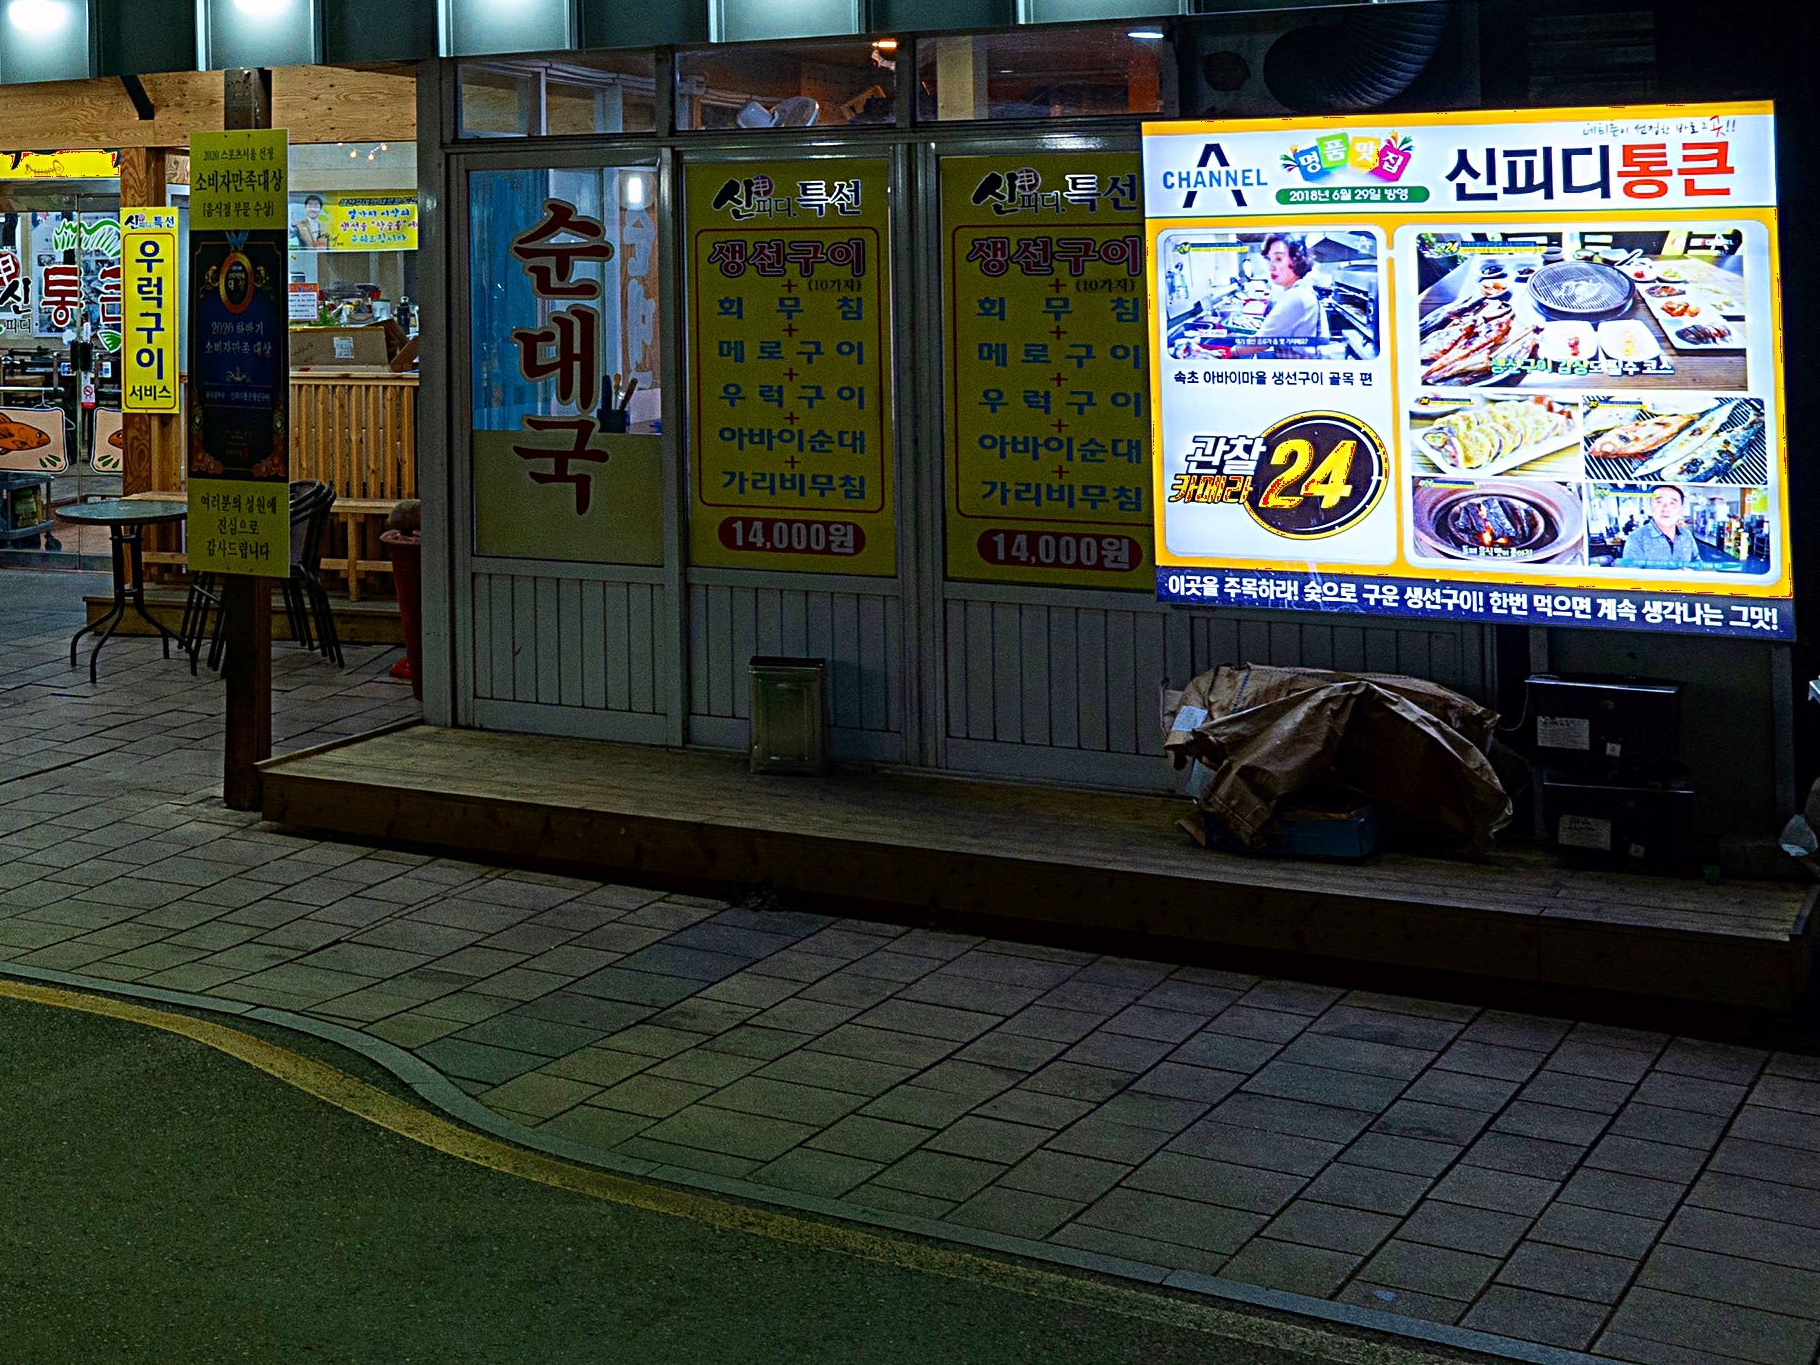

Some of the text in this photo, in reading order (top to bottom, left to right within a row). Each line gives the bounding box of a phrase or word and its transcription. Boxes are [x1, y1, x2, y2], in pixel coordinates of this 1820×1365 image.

[195, 168, 283, 193] 소비자만족대상
[1063, 172, 1138, 213] 특선
[1163, 169, 1268, 189] CHANNEL
[797, 179, 862, 216] 특선
[1289, 188, 1408, 202] 2018년 6월 29일 방영
[707, 239, 866, 278] 생선구이
[967, 236, 1142, 276] 생선구이
[135, 240, 165, 379] 우럭구이
[510, 197, 614, 516] 순대국
[1642, 359, 1675, 376] 코스
[130, 384, 172, 401] 서비스
[1174, 370, 1373, 386] 속초 아바이마을 생선구이 골목 편
[718, 427, 866, 454] 아바이순대
[978, 435, 1142, 464] 아바이순대
[1185, 435, 1266, 475] 관찰
[721, 470, 866, 499] 가리비무침
[1259, 439, 1358, 509] 24
[200, 492, 277, 515] 여러분의 성원에
[981, 481, 1143, 512] 가리비무침
[1168, 474, 1253, 504] 카메라
[217, 517, 259, 535] 진심으로
[207, 538, 270, 560] 감사드립니다
[1168, 575, 1219, 596] 이곳을
[1223, 577, 1299, 601] 주목하라!
[1362, 584, 1399, 607] 구운
[1404, 586, 1484, 613] 생선구이!
[1489, 591, 1528, 616] 한번
[1533, 594, 1591, 620] 먹으면
[1596, 598, 1637, 621] 계속
[1641, 600, 1724, 627] 생각나는
[1728, 605, 1779, 630] 그맛!
